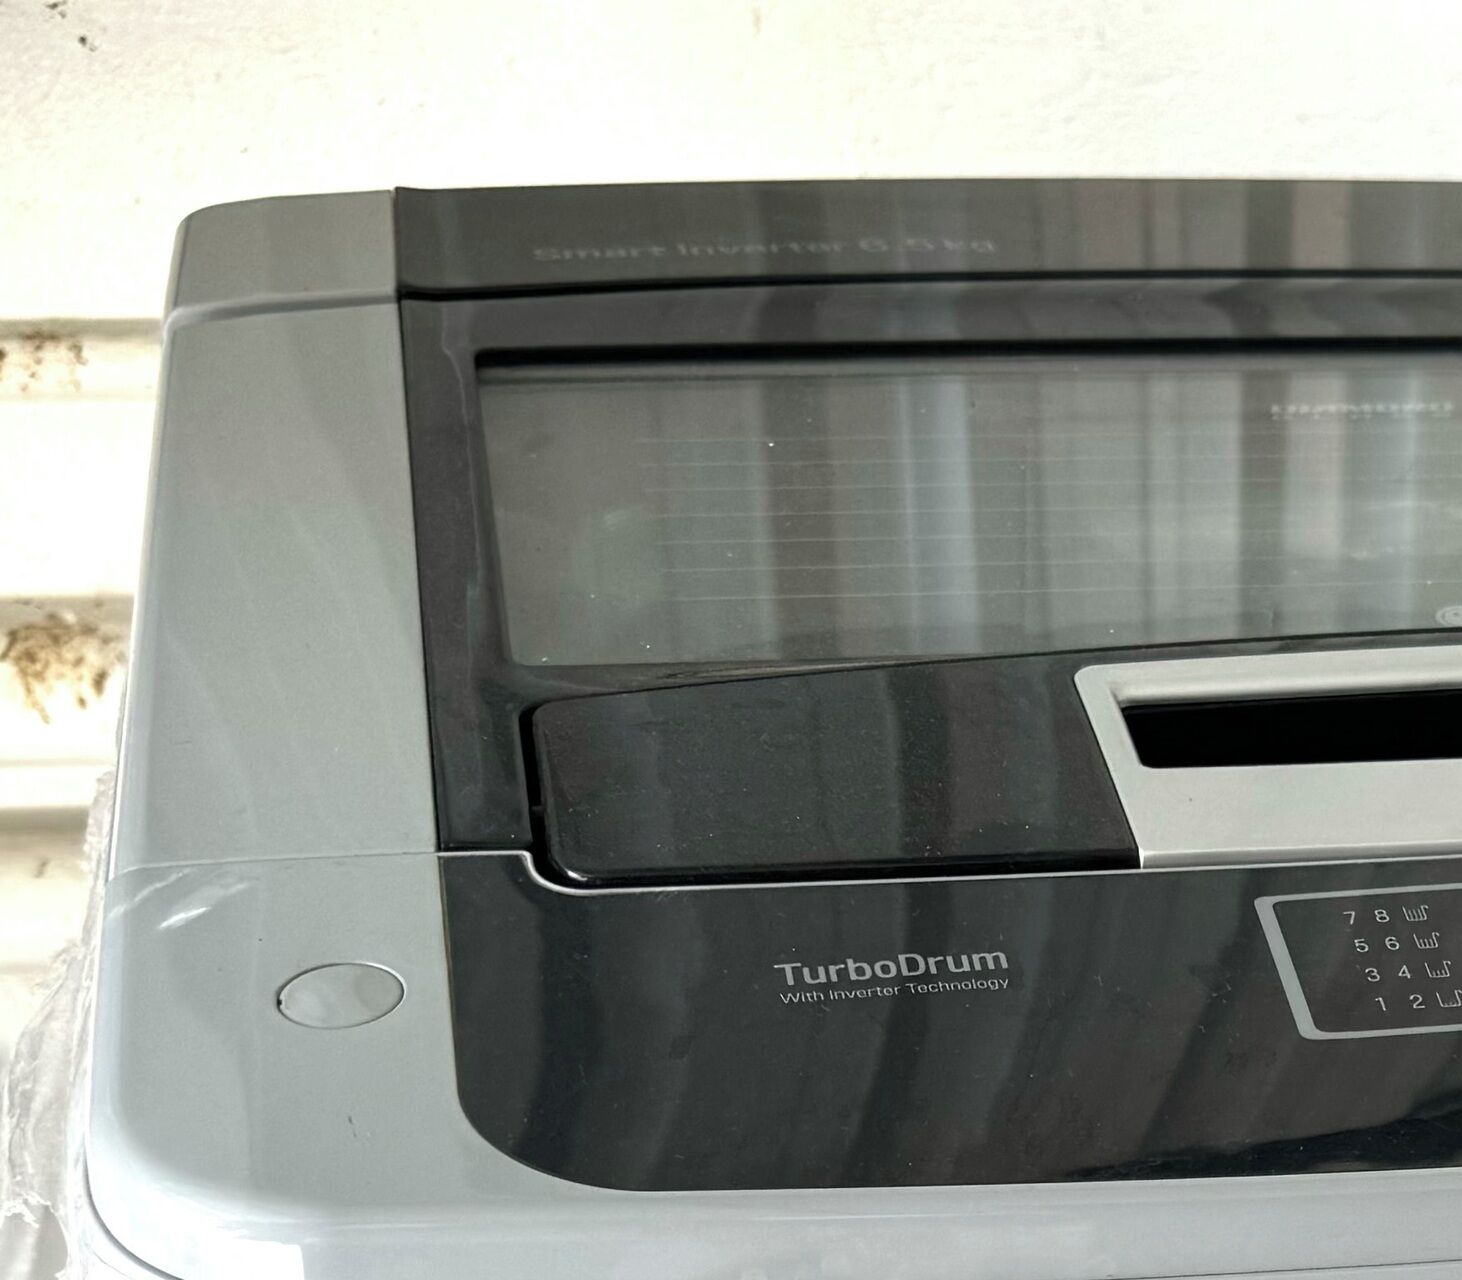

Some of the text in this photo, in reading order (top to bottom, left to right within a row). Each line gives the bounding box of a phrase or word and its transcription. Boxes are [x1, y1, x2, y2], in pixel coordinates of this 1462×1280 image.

[1343, 908, 1391, 926] 7 8
[1354, 936, 1401, 953] 5 6
[773, 951, 1009, 986] TurboDrum
[1365, 964, 1412, 983] 3 4
[780, 978, 1010, 1005] With Inverter Technology
[1375, 994, 1426, 1012] 1 2
